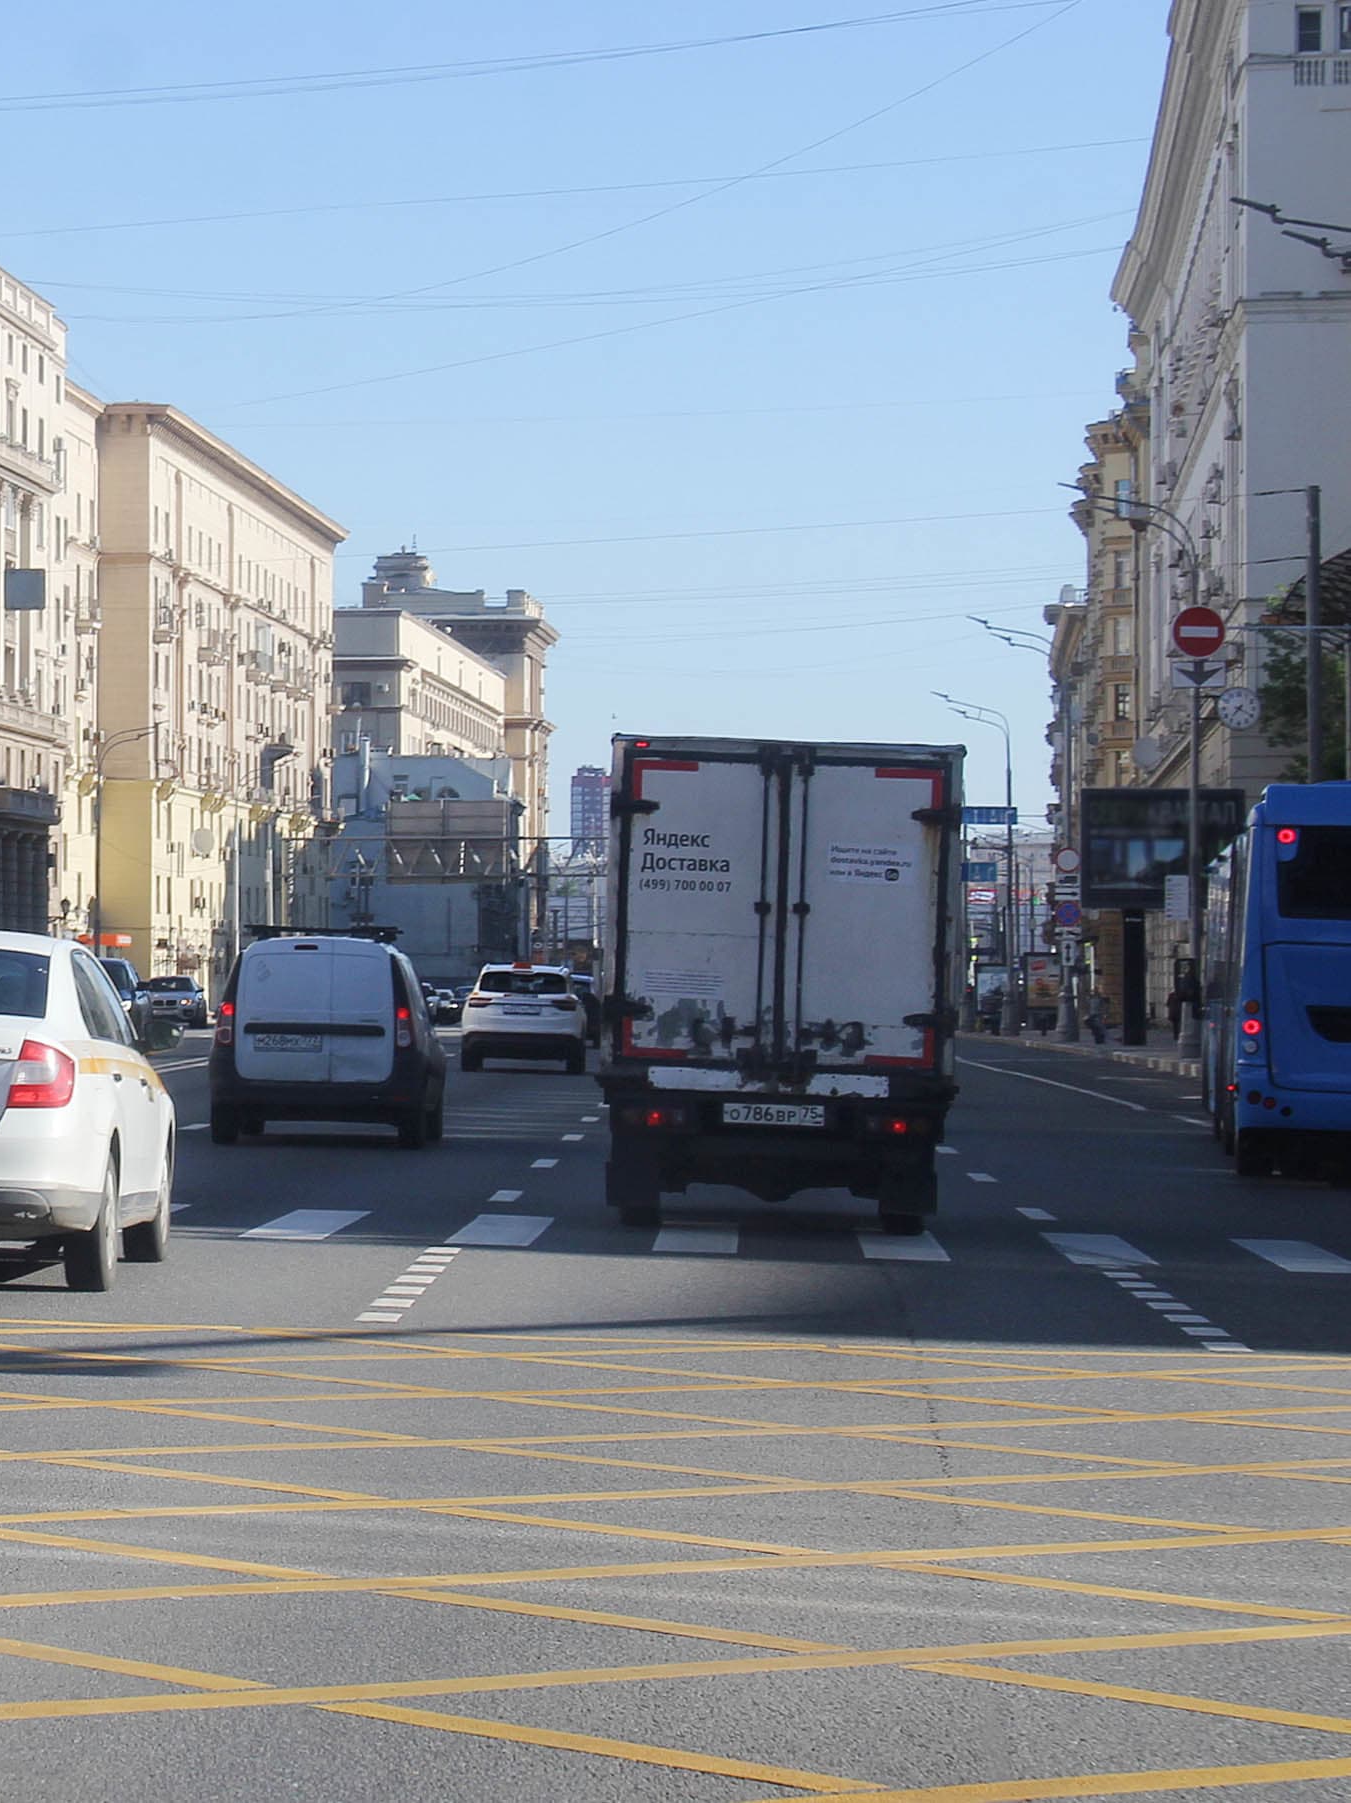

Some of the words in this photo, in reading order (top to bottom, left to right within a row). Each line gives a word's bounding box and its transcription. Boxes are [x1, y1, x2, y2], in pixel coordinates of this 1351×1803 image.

[643, 829, 711, 848] Яндекс
[641, 853, 730, 873] Доставка
[830, 857, 912, 868] dostavka.yandex.ru
[854, 868, 884, 878] Яндекс
[639, 879, 671, 892] (499)
[675, 880, 696, 891] 700
[699, 881, 714, 892] 00
[717, 881, 732, 892] 07
